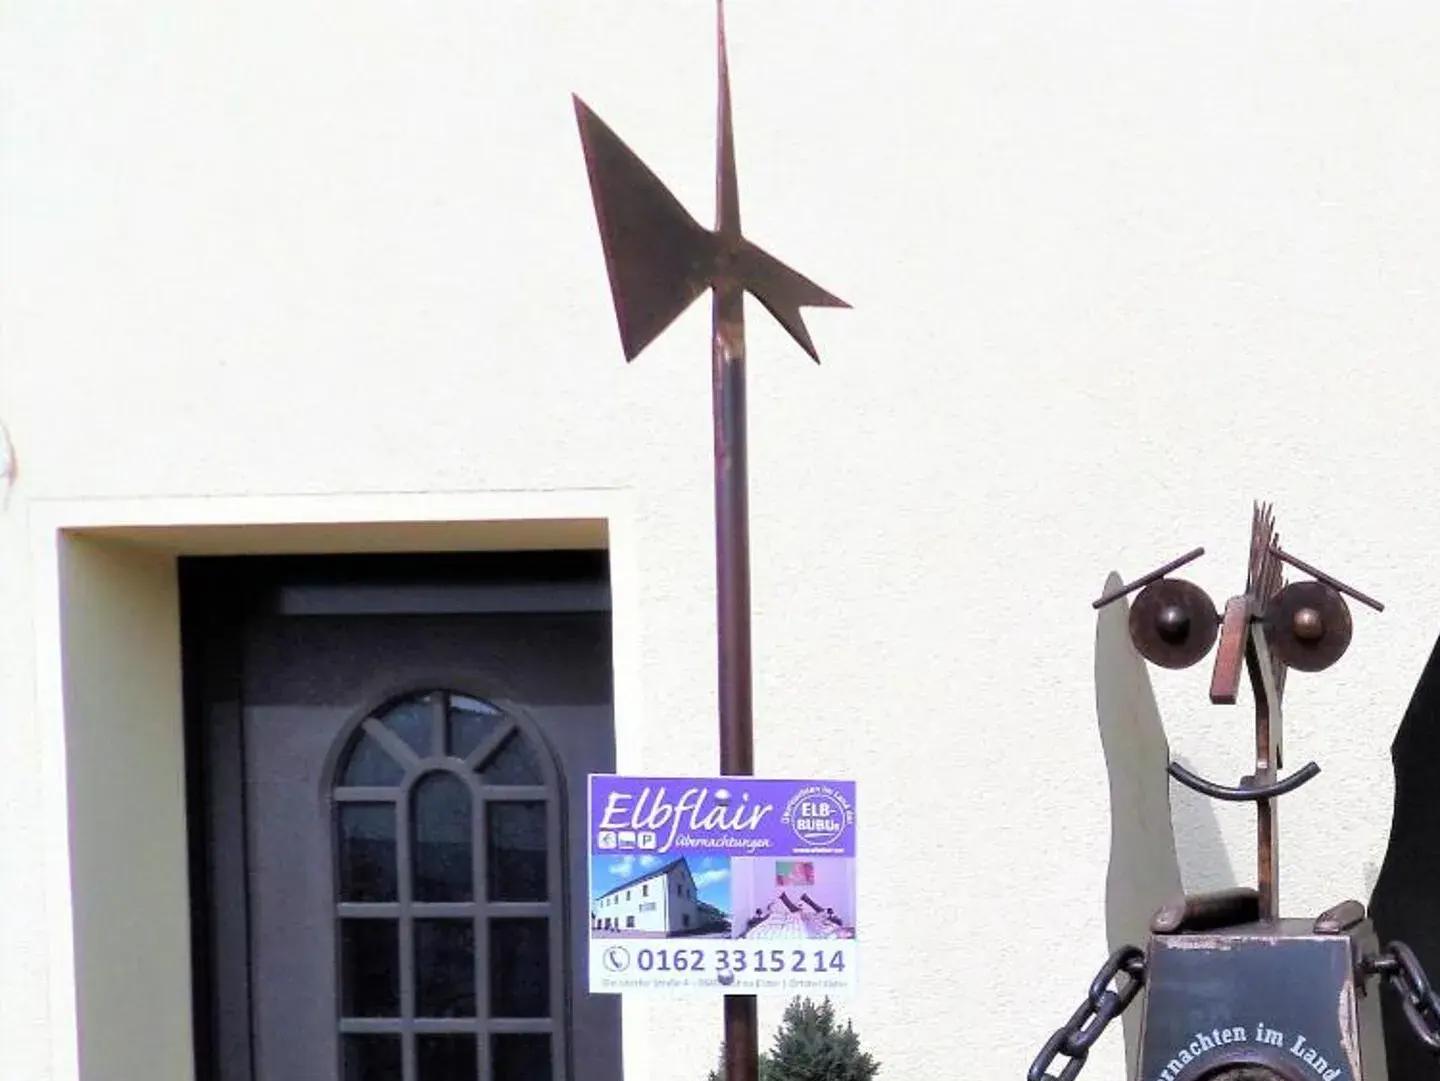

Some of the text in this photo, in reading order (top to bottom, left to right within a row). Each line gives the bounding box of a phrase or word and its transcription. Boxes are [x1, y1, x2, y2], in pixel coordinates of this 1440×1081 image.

[600, 787, 773, 853] Elbflair
[802, 802, 836, 817] ELB-
[637, 948, 705, 971] 0162
[1255, 1022, 1284, 1047] im
